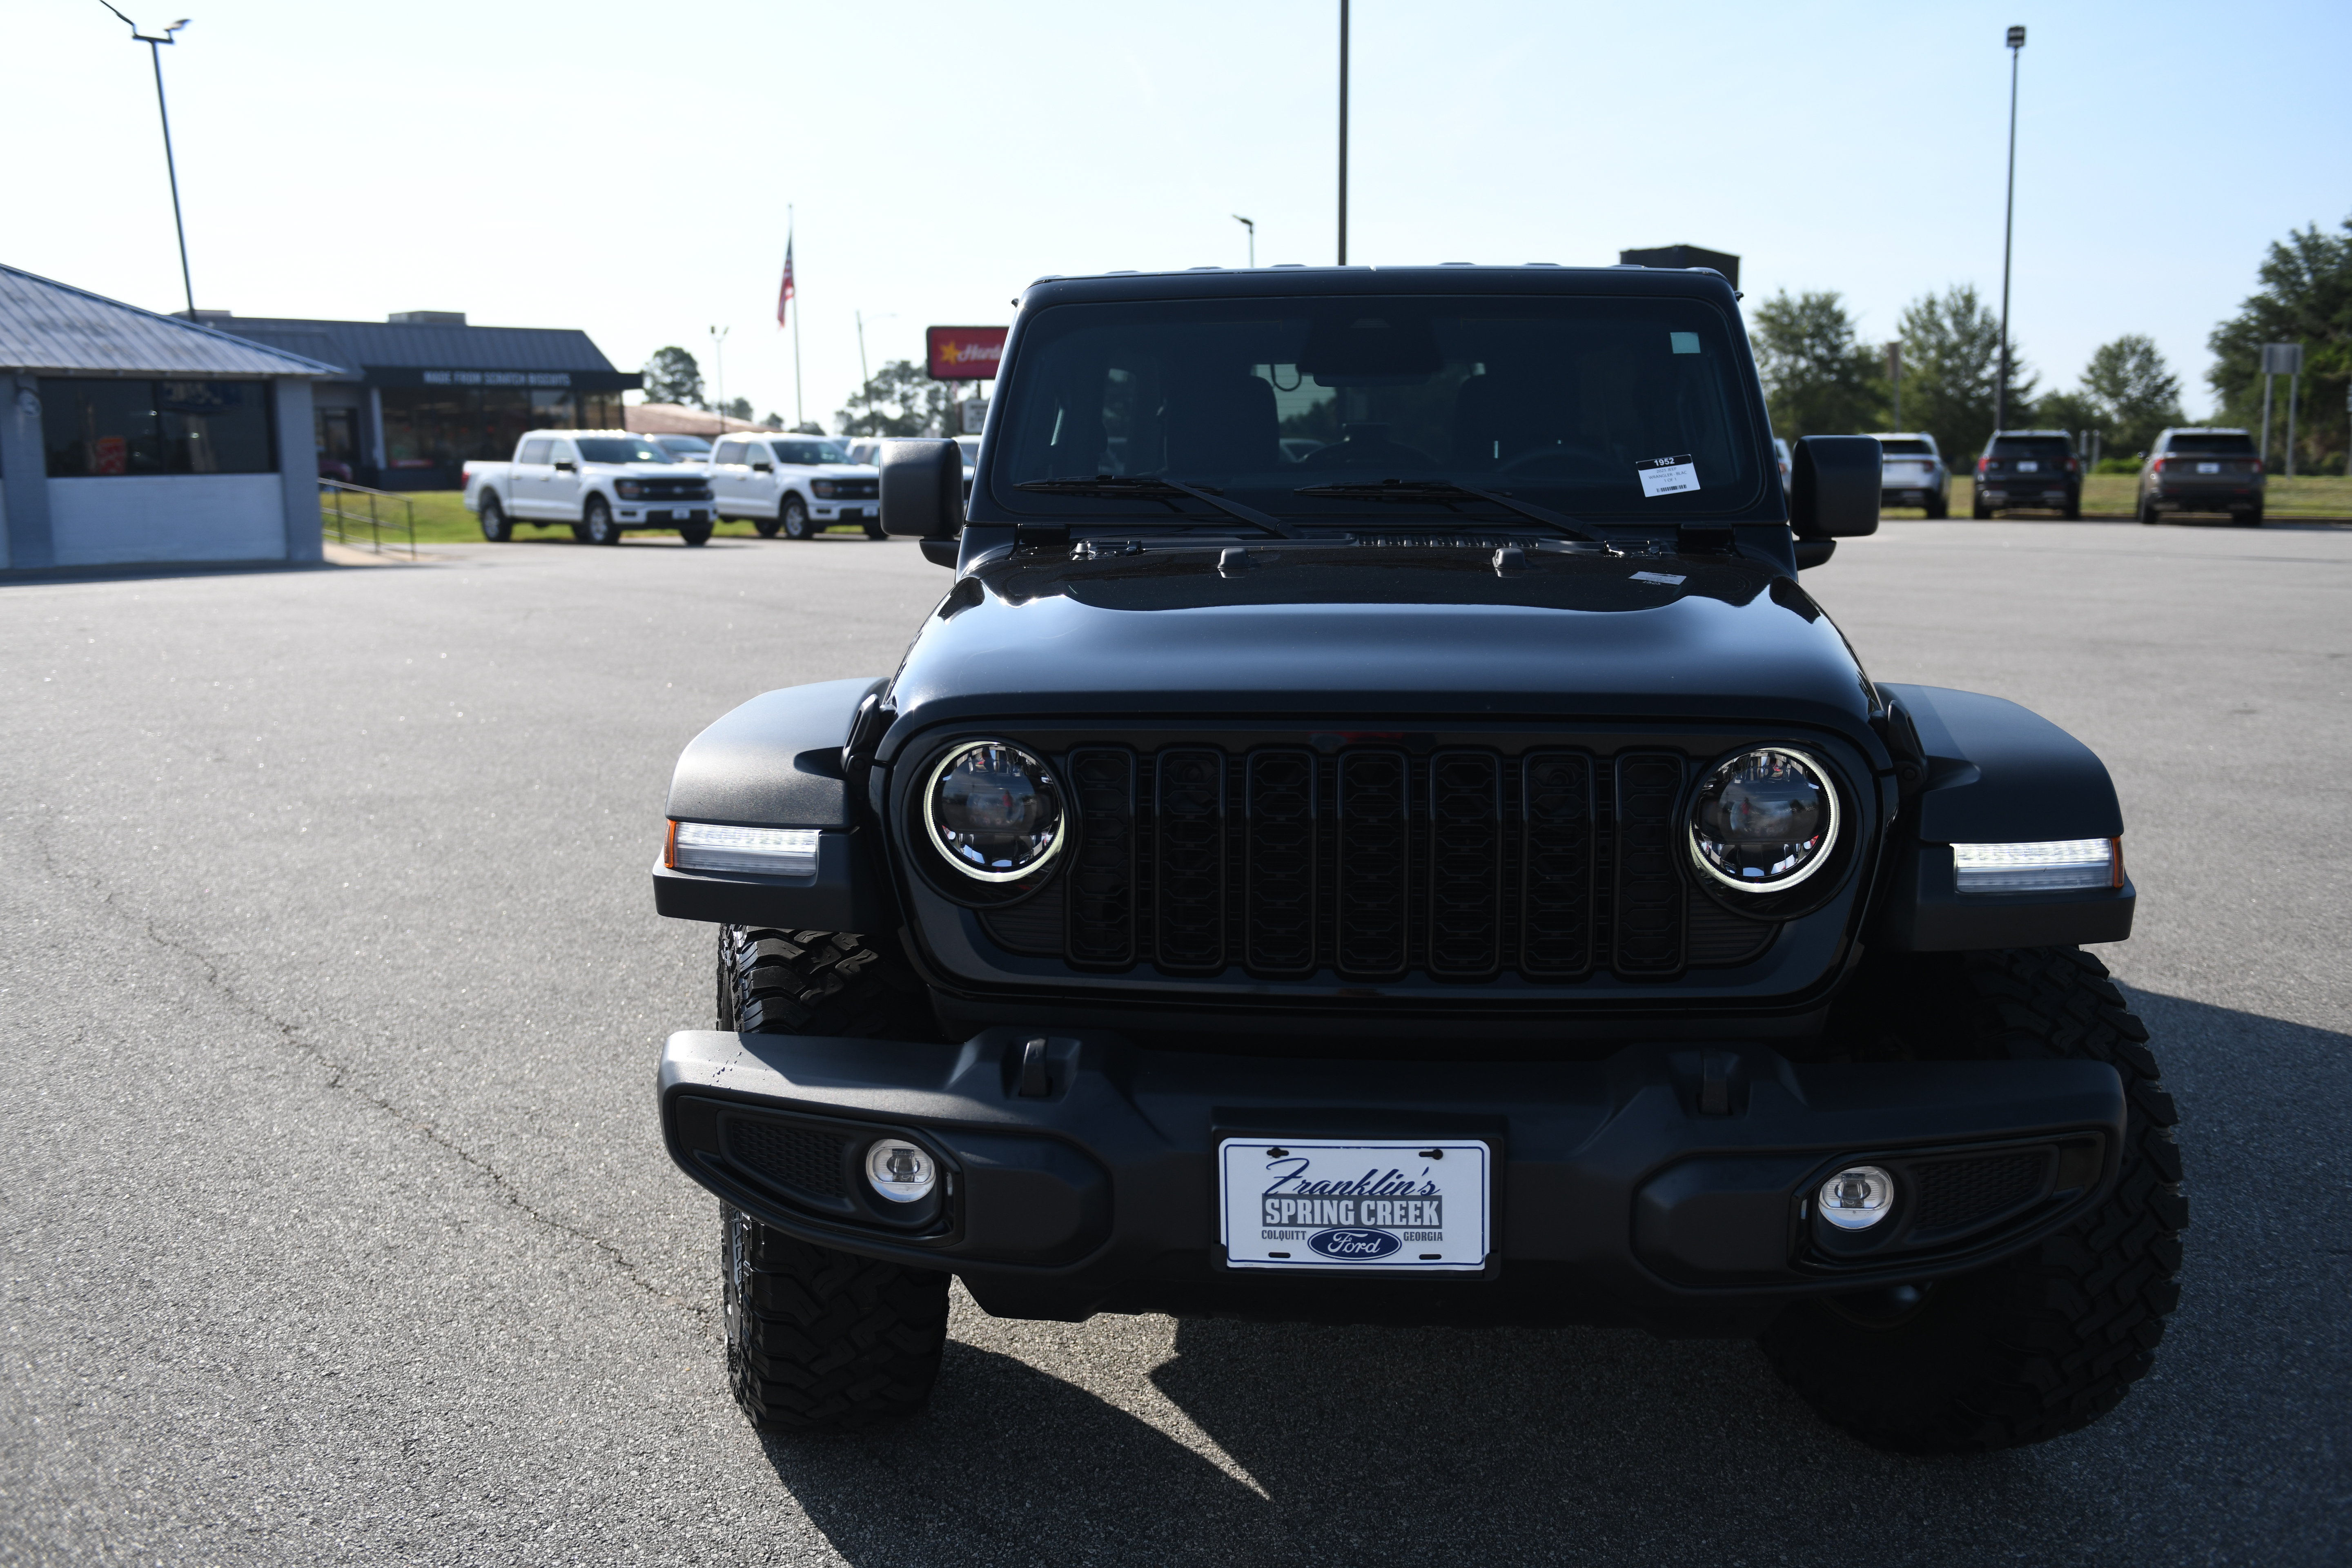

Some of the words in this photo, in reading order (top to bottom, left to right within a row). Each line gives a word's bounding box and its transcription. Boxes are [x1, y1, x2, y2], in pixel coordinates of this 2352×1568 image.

[1654, 457, 1675, 466] 1952
[1264, 1158, 1441, 1196] Franklin's
[1265, 1198, 1355, 1225] SPRING
[1361, 1200, 1439, 1225] CREEK
[1262, 1230, 1306, 1241] COLQUITT
[1403, 1232, 1443, 1241] GEORGIA
[1327, 1232, 1381, 1253] Ford
